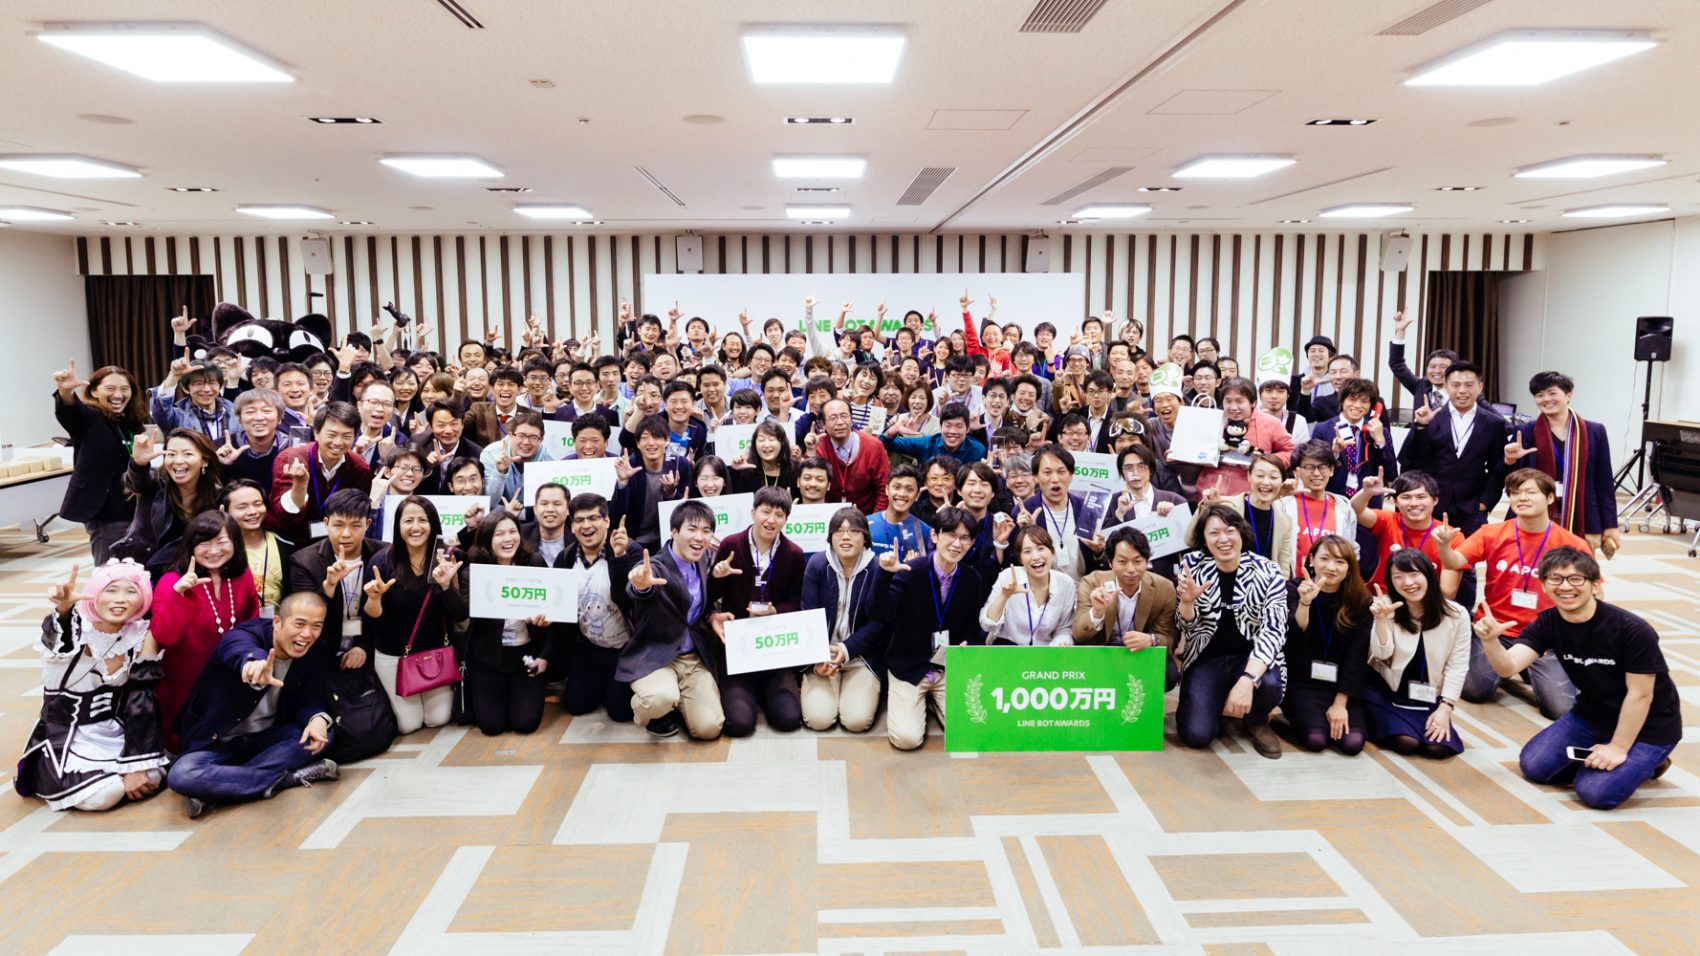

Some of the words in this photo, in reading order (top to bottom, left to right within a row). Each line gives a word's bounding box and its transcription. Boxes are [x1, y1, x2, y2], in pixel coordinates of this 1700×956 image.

[799, 319, 831, 332] LNE
[785, 521, 826, 534] 50万円
[501, 586, 547, 600] 50万円
[755, 632, 799, 649] 50万円
[1021, 670, 1059, 681] GRAND
[1062, 670, 1086, 681] PRIX
[990, 686, 1116, 714] 1,000万円
[1017, 719, 1035, 728] LINE
[1036, 719, 1054, 728] BOT
[1054, 719, 1091, 728] AWARDS
